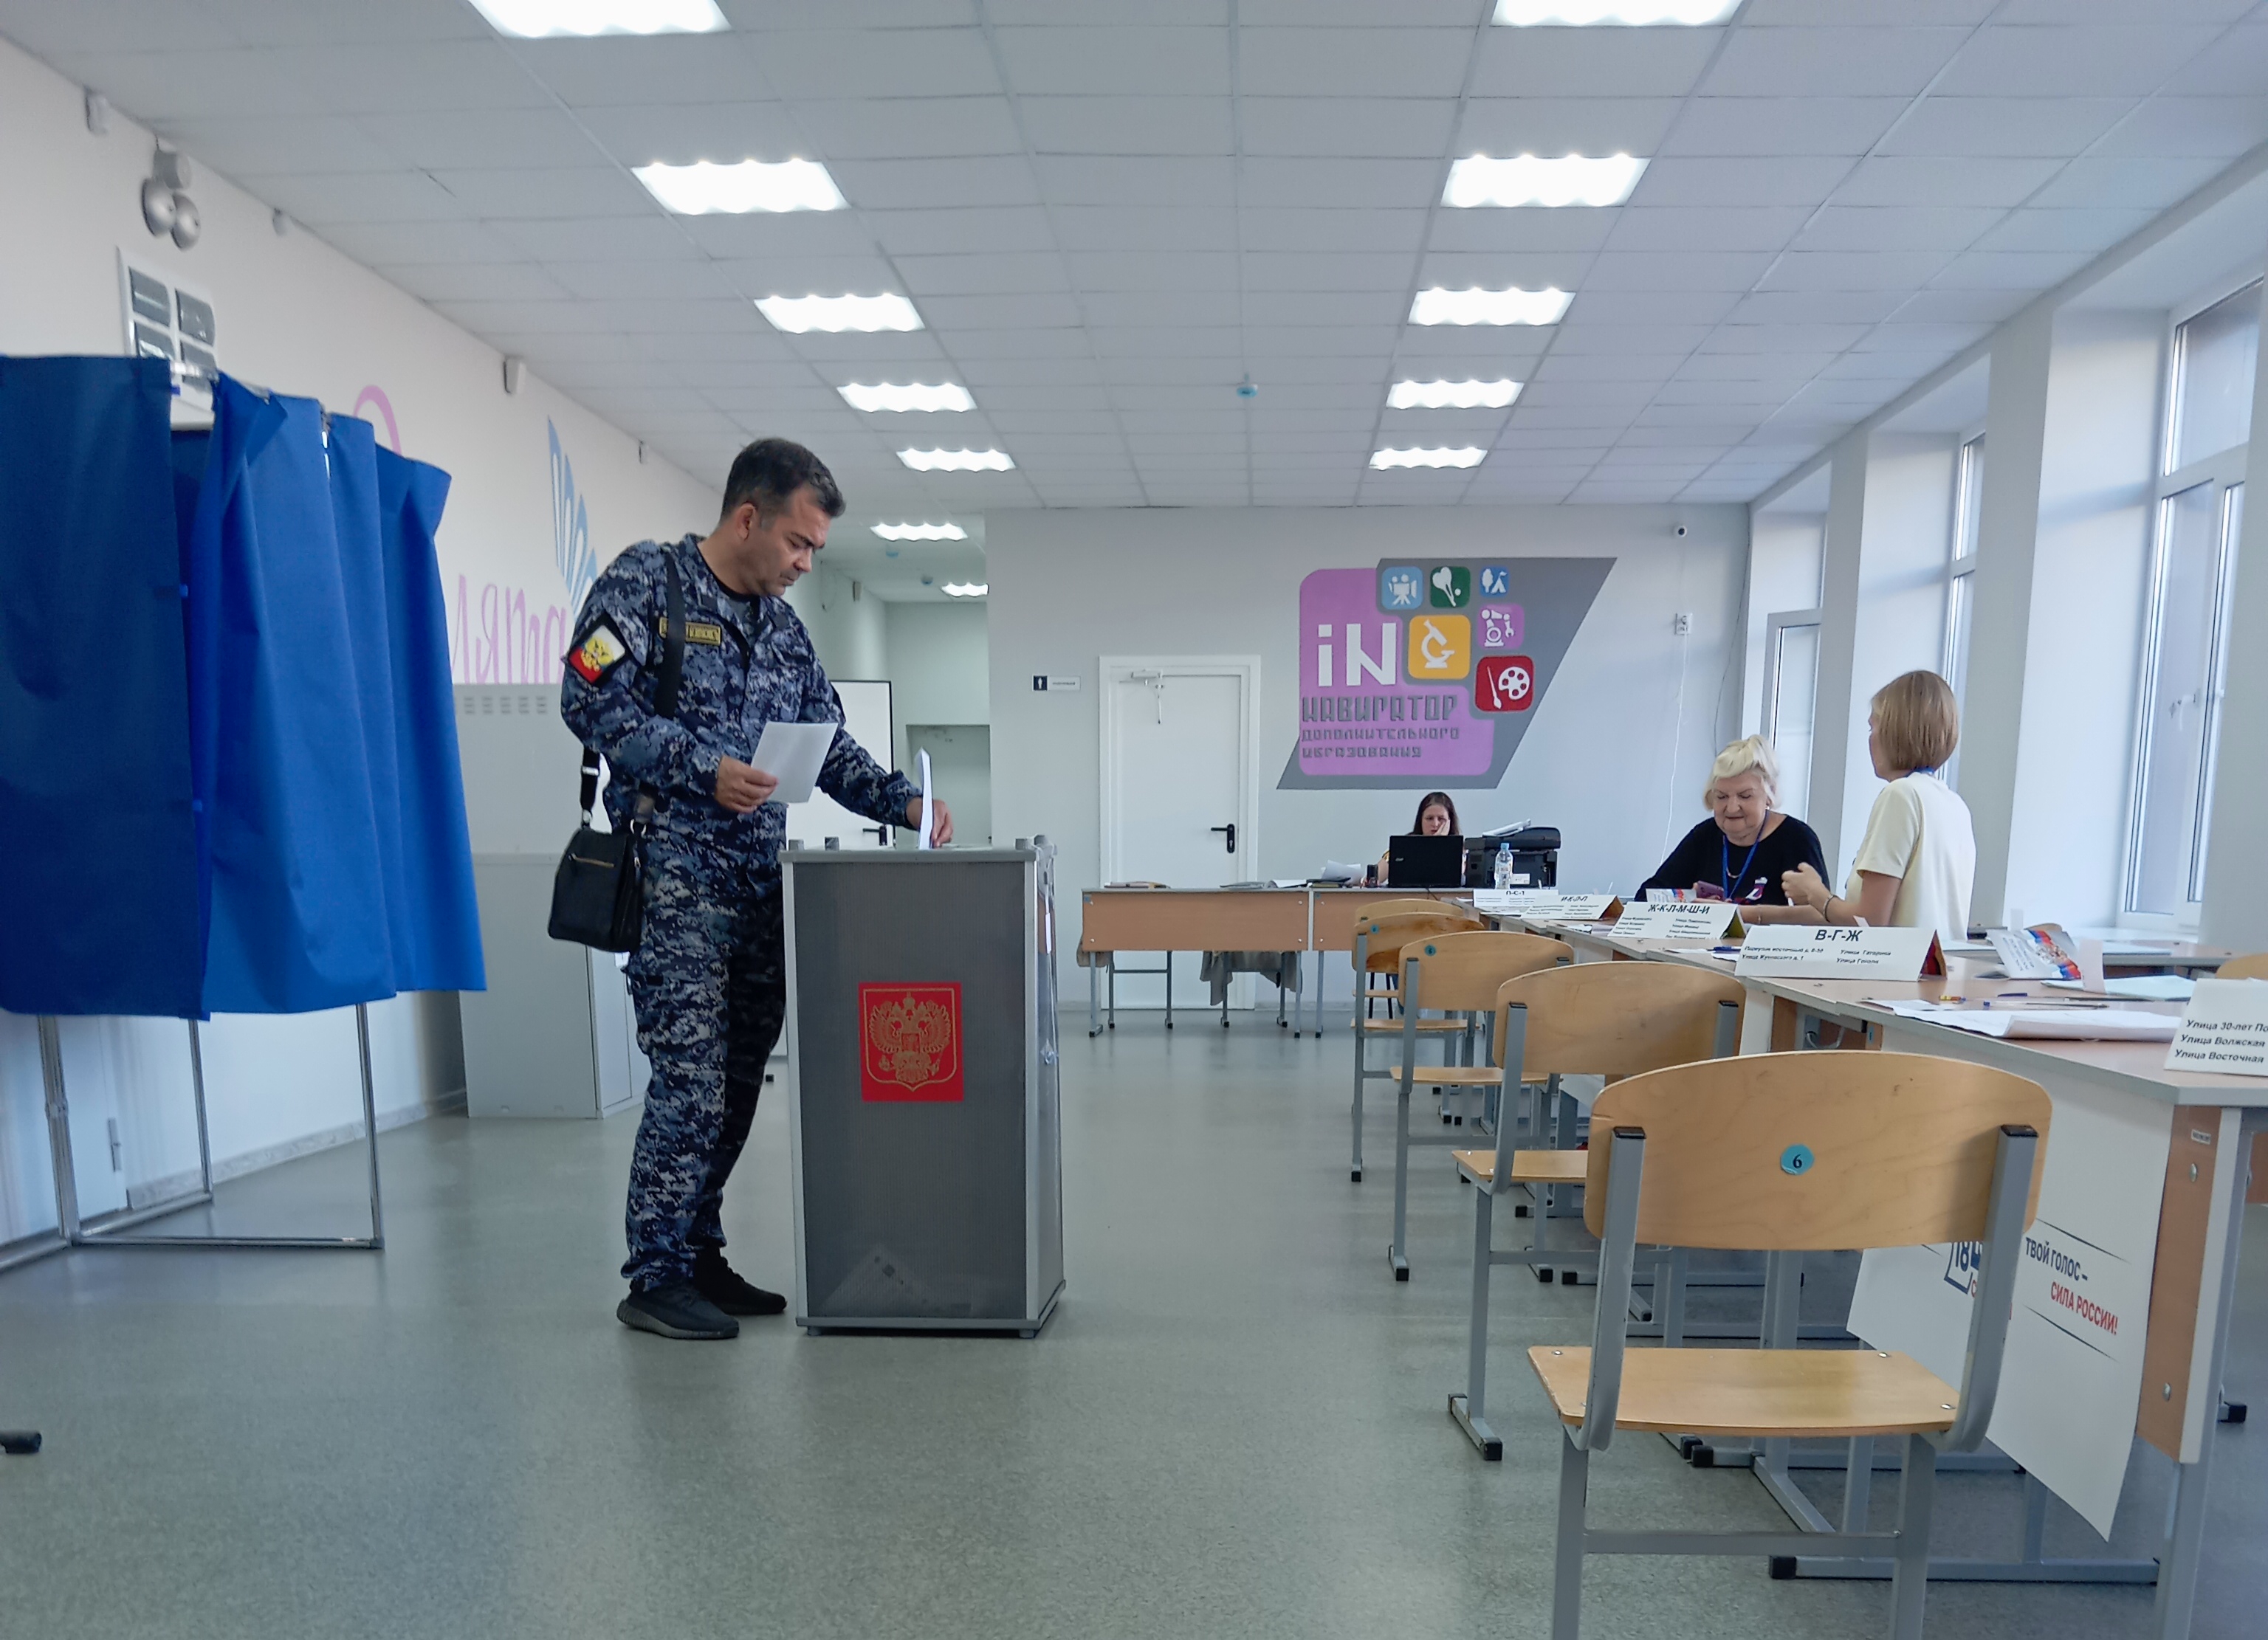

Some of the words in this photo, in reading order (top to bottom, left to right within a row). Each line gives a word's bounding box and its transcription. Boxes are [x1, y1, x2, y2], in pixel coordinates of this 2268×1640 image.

[1302, 695, 1458, 723] НАВИГАТОР
[1301, 726, 1460, 742] ДОПОЛНИТЕЛЬНОГО
[1814, 929, 1863, 943] В-Г-Ж
[2186, 1019, 2218, 1030] Улица
[2220, 1021, 2253, 1031] 30-лет
[2180, 1033, 2212, 1045] Улица
[2214, 1036, 2266, 1047] Волжская
[2174, 1048, 2206, 1060] Улица
[2208, 1052, 2264, 1064] Восточная
[1793, 1154, 1803, 1169] 6
[2025, 1237, 2049, 1265] ТВОЙ
[2050, 1249, 2080, 1281] ГОЛОС
[2050, 1281, 2075, 1311] СИЛА
[2076, 1295, 2119, 1335] РОССИИ!
